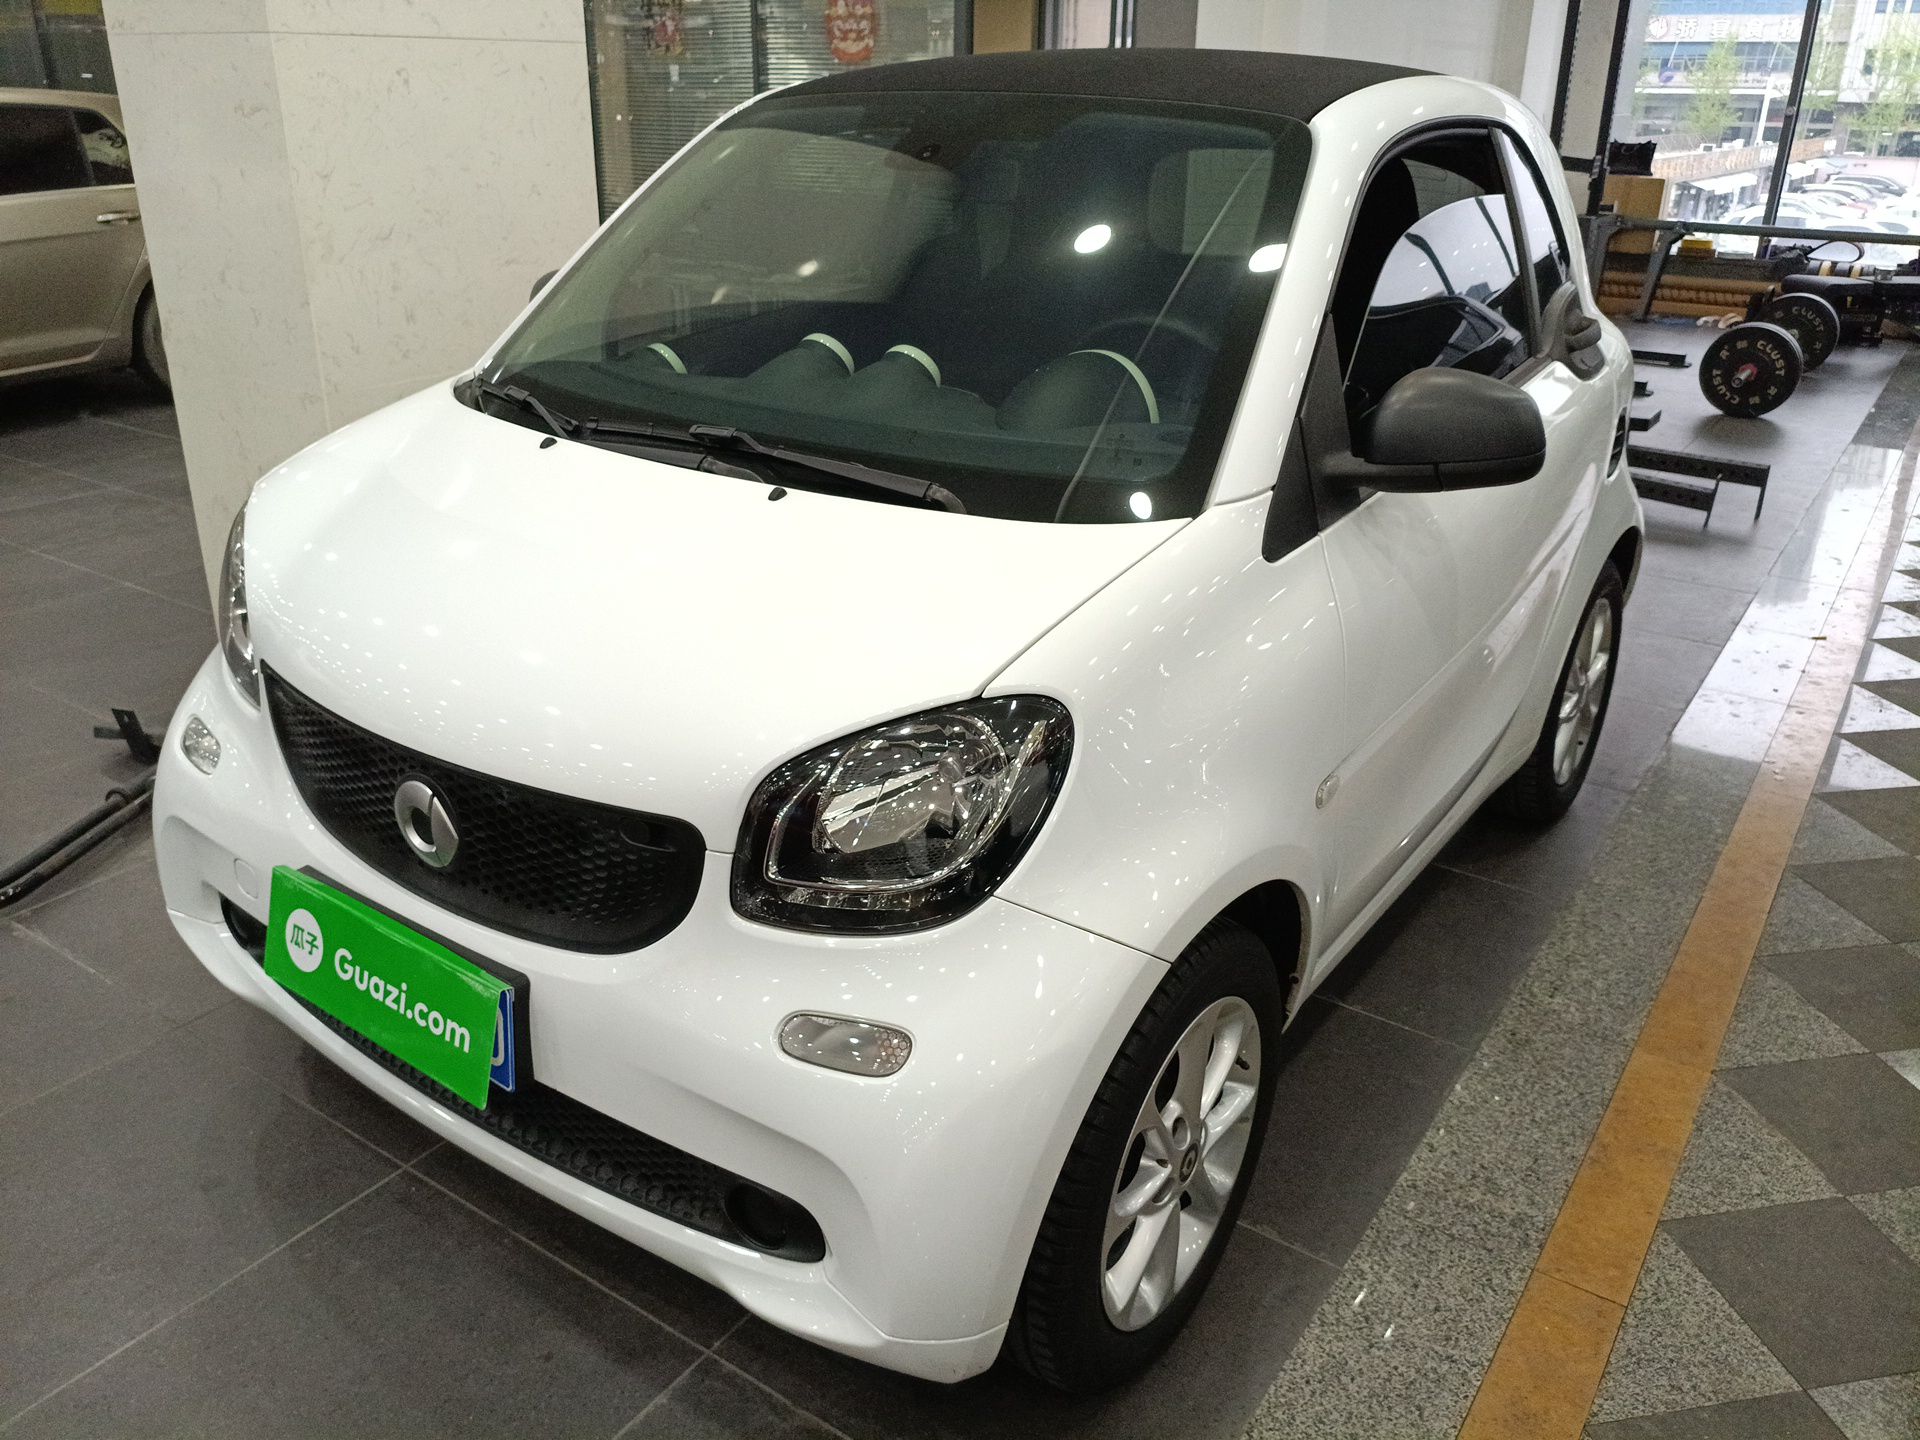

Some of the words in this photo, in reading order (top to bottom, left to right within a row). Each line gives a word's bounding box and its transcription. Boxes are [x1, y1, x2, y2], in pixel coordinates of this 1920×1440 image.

[1757, 340, 1785, 377] CLUST
[289, 923, 320, 955] 瓜子
[334, 947, 471, 1053] Guazi.com
